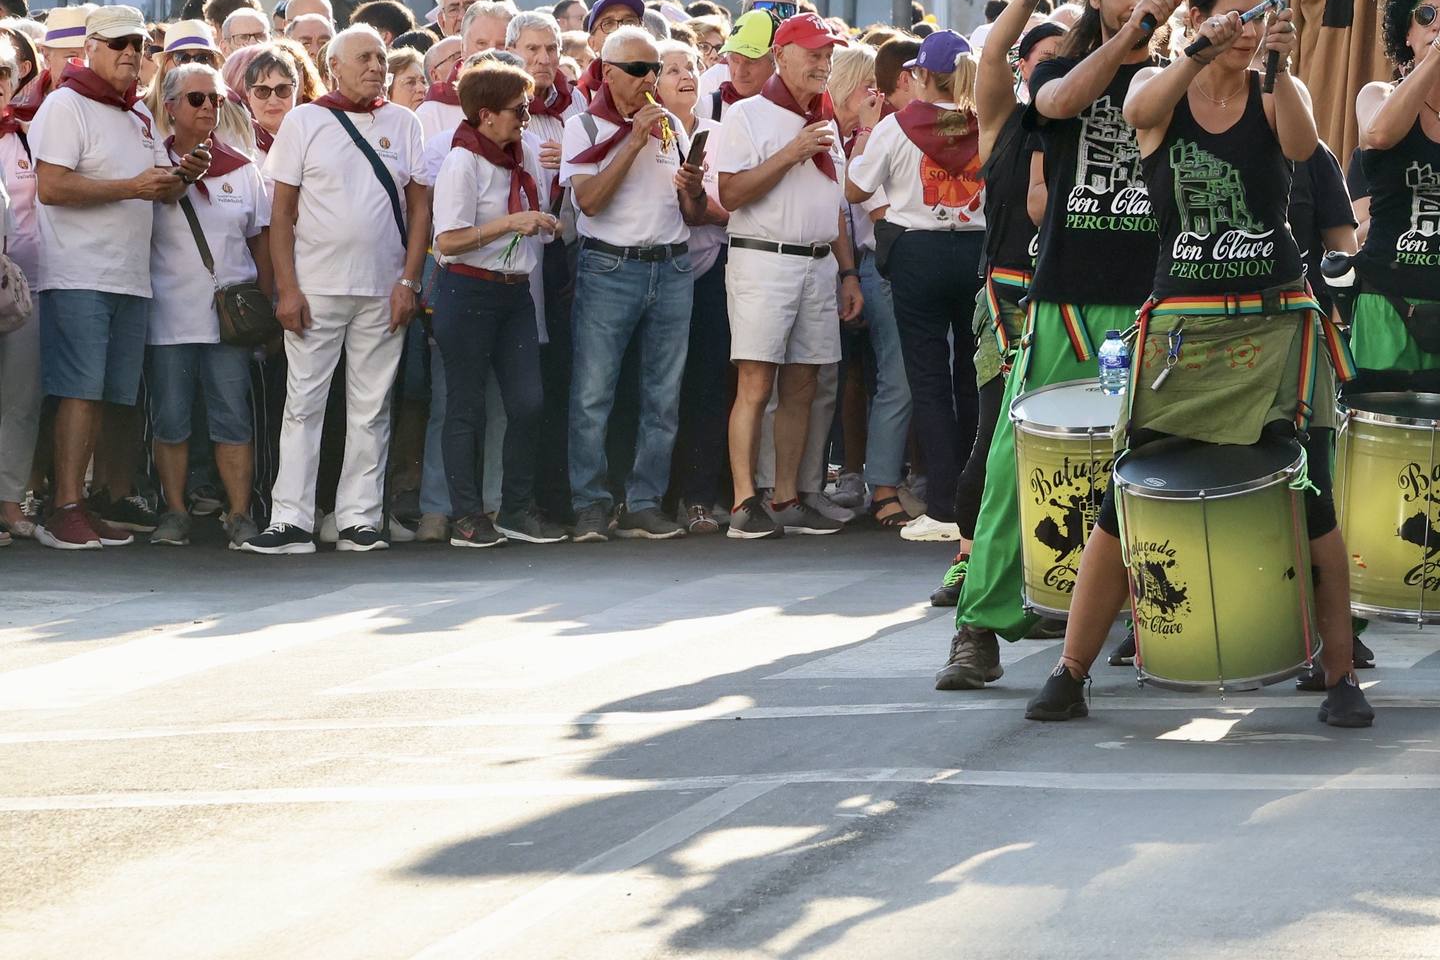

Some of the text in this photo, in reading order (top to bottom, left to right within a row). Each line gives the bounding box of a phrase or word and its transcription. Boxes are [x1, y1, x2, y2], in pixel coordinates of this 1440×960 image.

[1066, 185, 1111, 213] Con
[1172, 228, 1275, 260] Con Clave
[1396, 229, 1438, 252] Con
[1150, 615, 1183, 635] Clave
